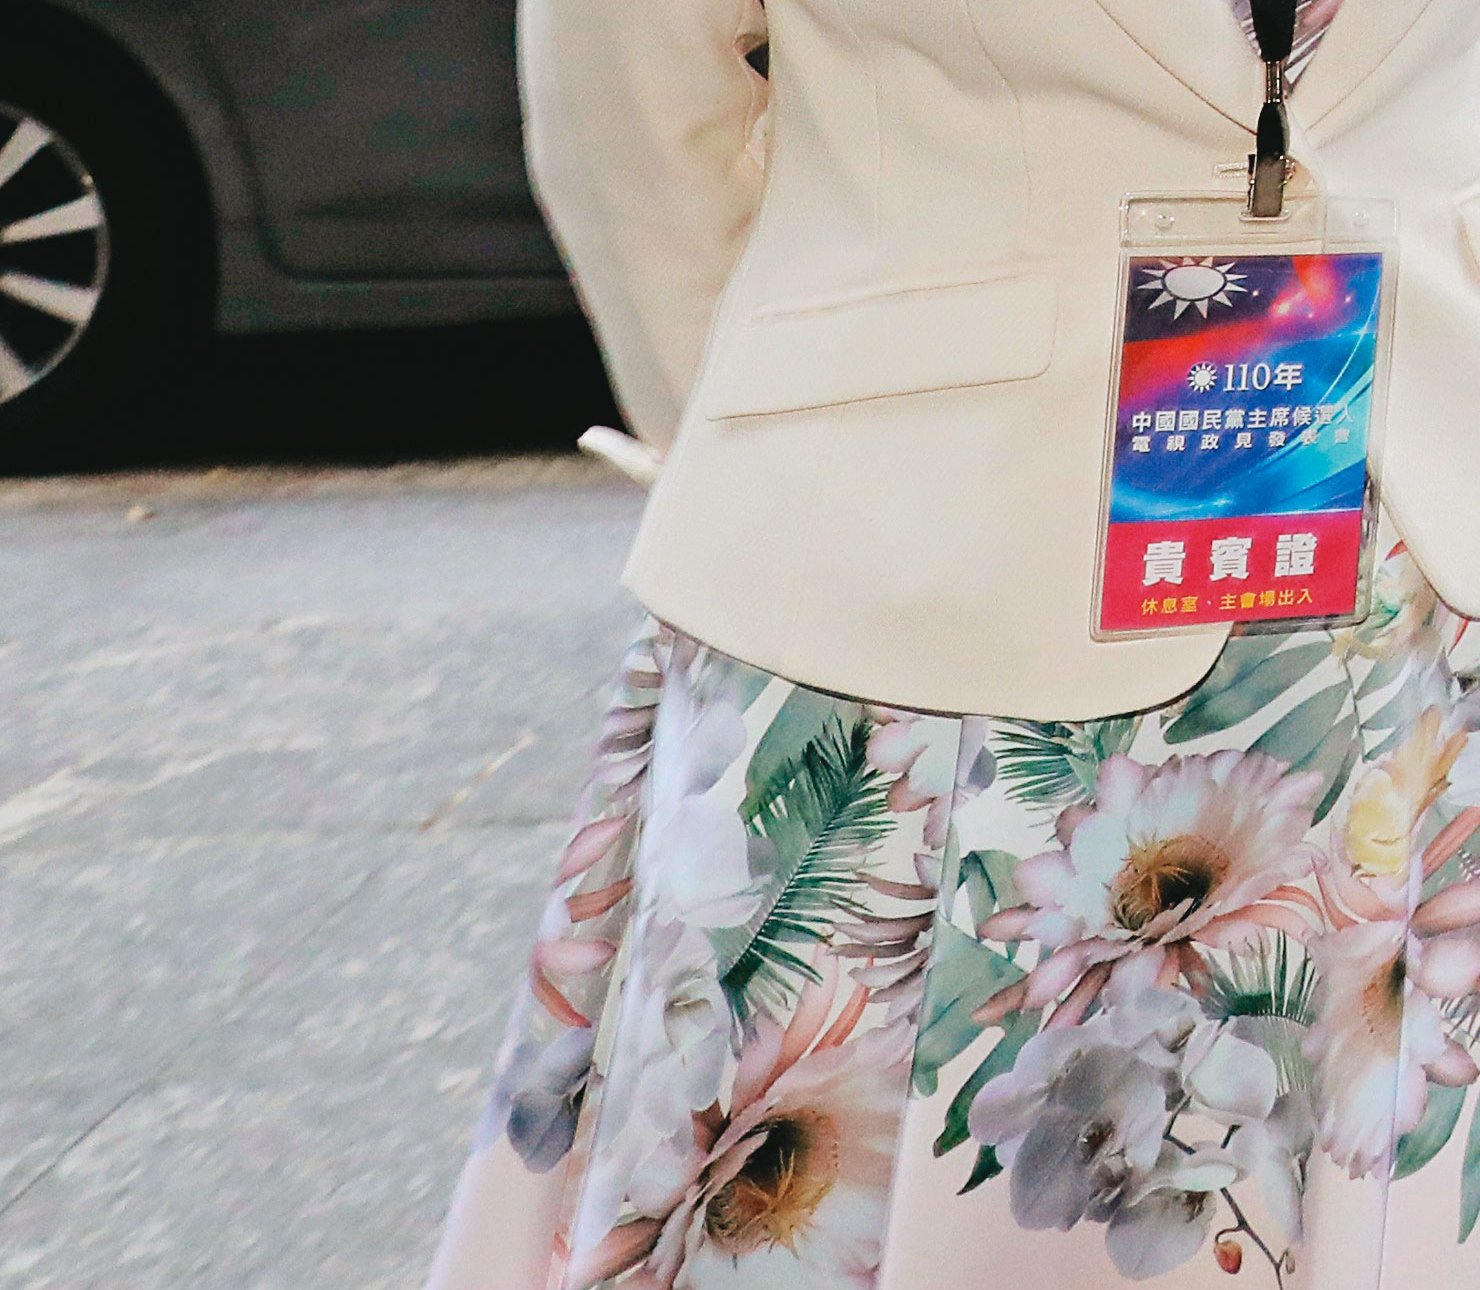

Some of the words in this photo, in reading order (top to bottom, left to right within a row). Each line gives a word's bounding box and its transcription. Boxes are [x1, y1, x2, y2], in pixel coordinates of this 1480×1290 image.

[1222, 363, 1304, 392] 110年
[1131, 404, 1354, 434] 中國國民黨主席候選人
[1130, 429, 1352, 452] 電視政見發表會
[1141, 532, 1318, 587] 貴賓證
[1140, 587, 1313, 616] 休息室、主會場出入
